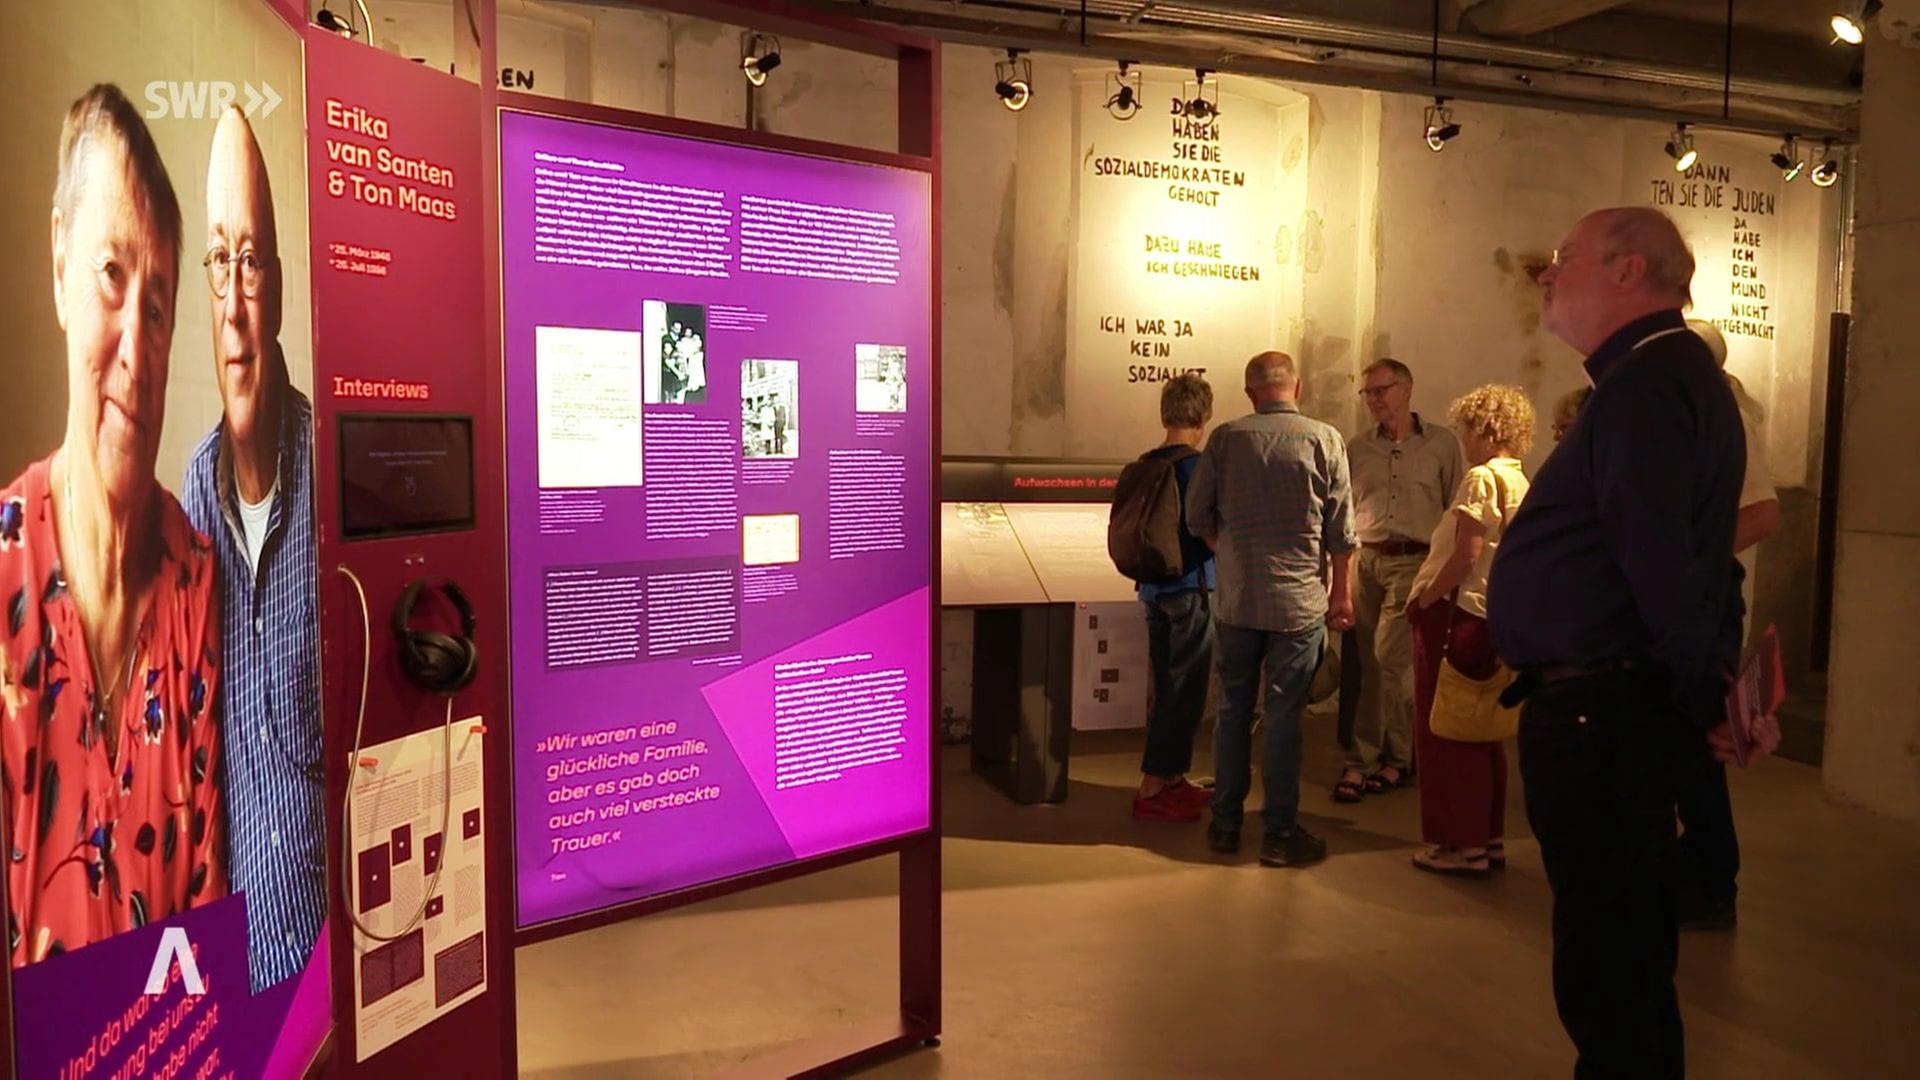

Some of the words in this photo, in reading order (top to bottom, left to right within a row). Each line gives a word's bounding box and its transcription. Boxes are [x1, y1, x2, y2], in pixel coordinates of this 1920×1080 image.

[496, 67, 534, 89] EN
[326, 100, 389, 140] Erika
[1172, 117, 1219, 141] HABEN
[1172, 141, 1198, 161] SIE
[1201, 144, 1222, 163] DIE
[326, 140, 371, 170] van
[376, 150, 454, 189] Santen
[1094, 157, 1245, 187] SOZIALDEMOKRATEN
[328, 171, 345, 197] &
[350, 174, 392, 207] Ton
[398, 185, 457, 220] Maas
[1168, 185, 1220, 207] GEHOLT
[1679, 183, 1698, 207] SIE
[1704, 183, 1723, 208] DIE
[1732, 187, 1775, 216] JUDEN
[1734, 217, 1747, 229] DA
[1733, 232, 1761, 248] HABE
[1732, 249, 1754, 262] ICH
[1146, 261, 1169, 273] ICH
[1173, 262, 1260, 281] GESCHWIEGEN
[1732, 264, 1758, 279] DEN
[1731, 282, 1766, 300] MUND
[1731, 303, 1769, 321] NICHT
[1100, 316, 1125, 334] ICH
[1136, 318, 1167, 336] WAR
[1174, 320, 1193, 337] JA
[1130, 339, 1170, 357] KEIN
[333, 377, 430, 400] Interviews
[1014, 477, 1084, 489] Aufwachsen
[581, 728, 636, 747] waren
[640, 721, 677, 738] eine
[547, 751, 640, 782] glückliche
[548, 784, 591, 804] aber
[595, 780, 616, 796] es
[619, 773, 654, 795] gab
[657, 764, 700, 785] doch
[549, 807, 595, 829] auch
[599, 799, 630, 820] viel
[633, 786, 720, 814] versteckte
[100, 1020, 121, 1057] da
[149, 1009, 171, 1054] bei
[188, 1002, 218, 1056] nicht
